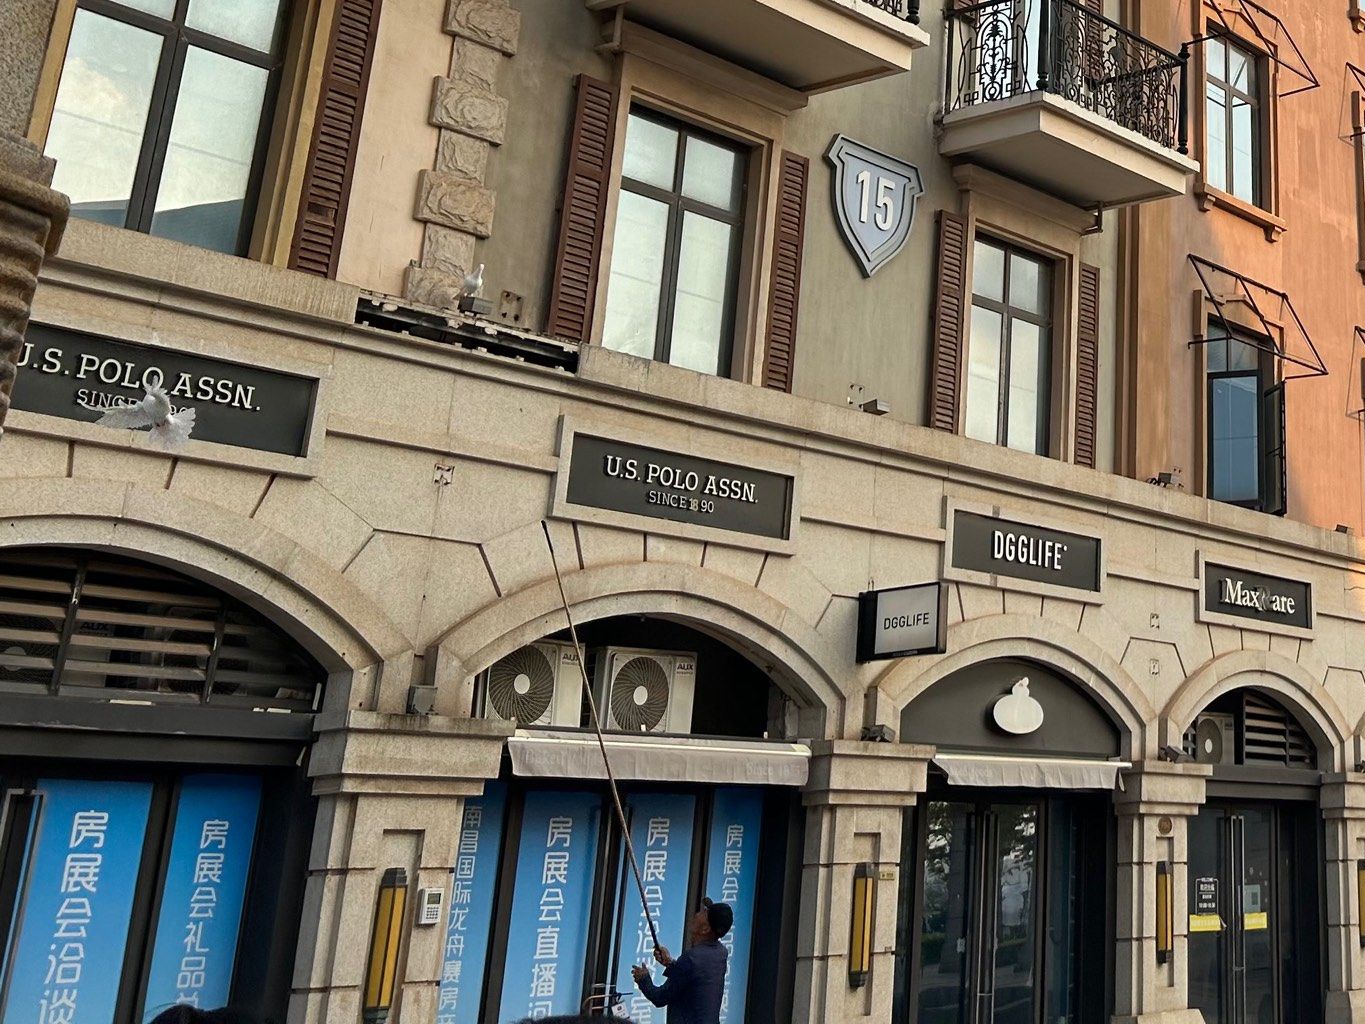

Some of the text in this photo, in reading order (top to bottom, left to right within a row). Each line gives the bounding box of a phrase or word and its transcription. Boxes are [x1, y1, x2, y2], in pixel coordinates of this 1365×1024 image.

[857, 170, 896, 231] 15
[76, 353, 164, 389] POLO
[171, 372, 261, 411] ASSN.
[606, 455, 759, 503] U.S. POLO ASSN.
[649, 490, 715, 513] SINCE 1890
[994, 530, 1062, 570] DGGLIFE
[883, 612, 930, 630] DGGLIFE
[677, 663, 694, 672] AUX
